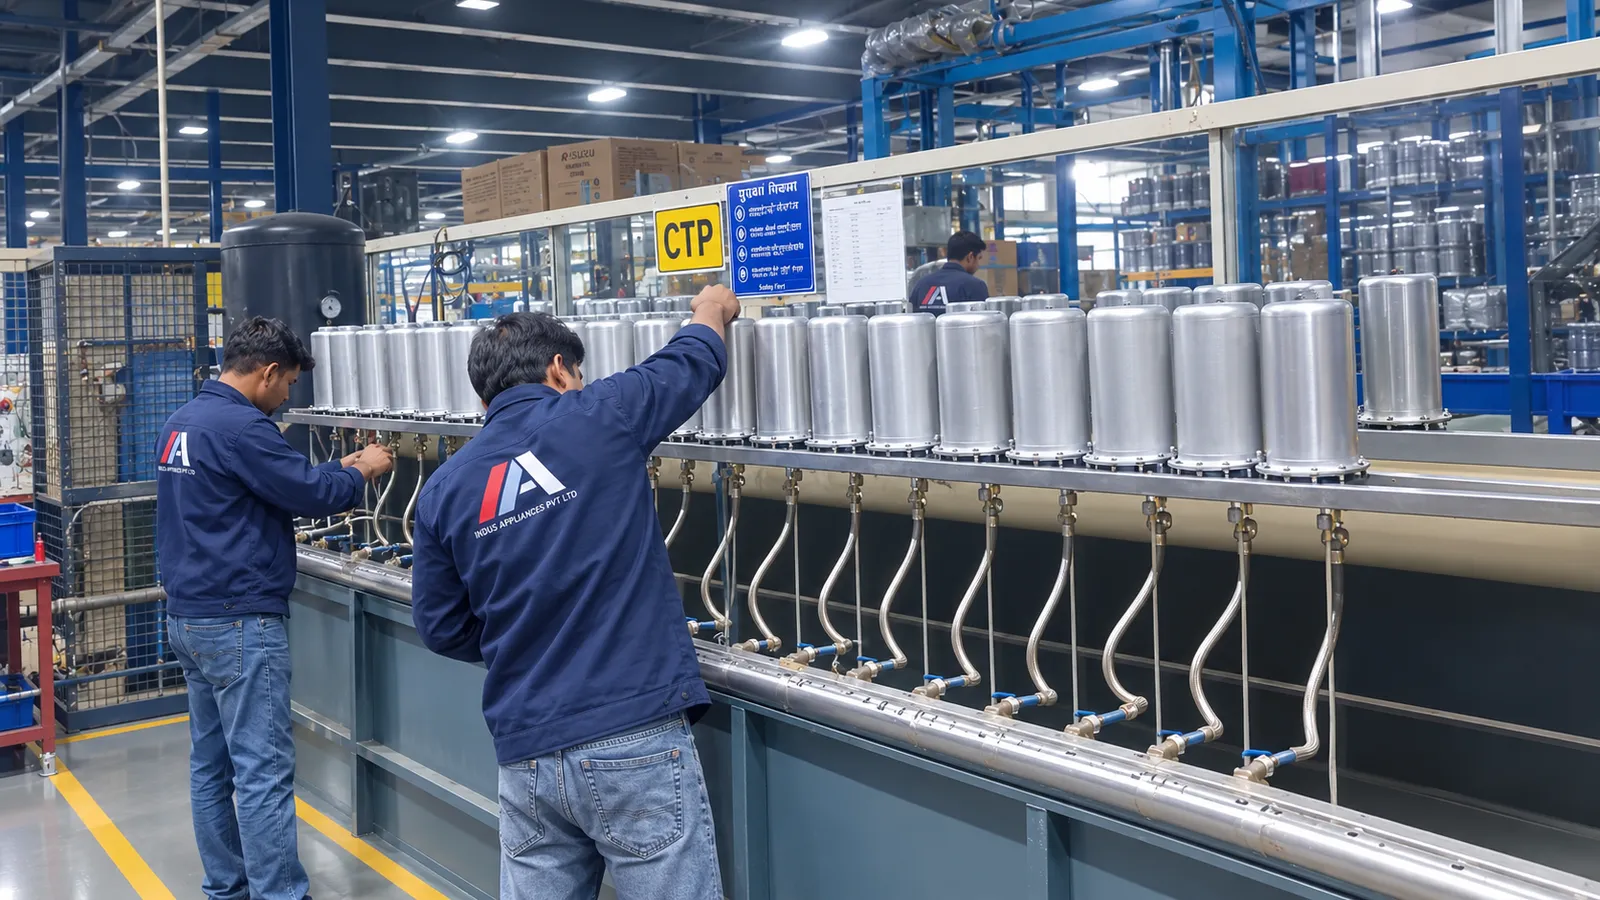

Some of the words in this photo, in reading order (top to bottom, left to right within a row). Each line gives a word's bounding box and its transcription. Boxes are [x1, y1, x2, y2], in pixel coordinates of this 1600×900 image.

[664, 219, 713, 259] CTP
[474, 523, 498, 539] INDUS
[499, 503, 545, 529] APPLIANCES
[546, 496, 561, 509] PVT
[563, 490, 578, 502] LTD
